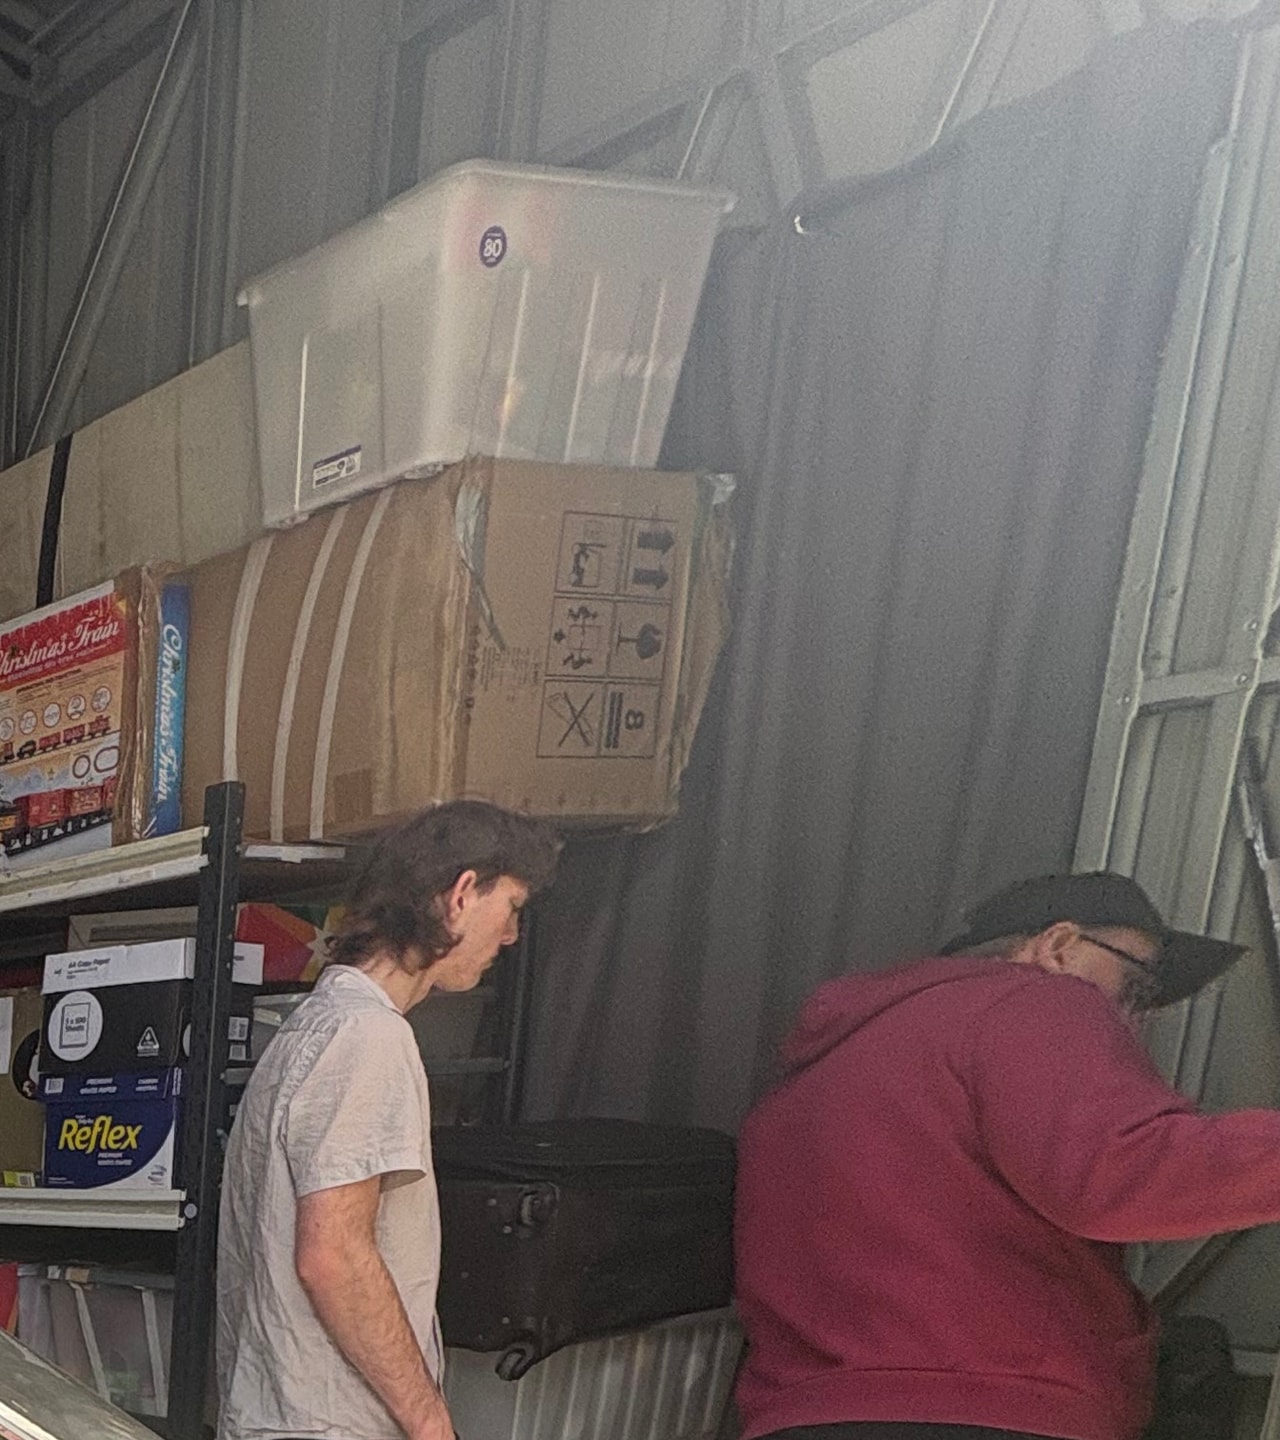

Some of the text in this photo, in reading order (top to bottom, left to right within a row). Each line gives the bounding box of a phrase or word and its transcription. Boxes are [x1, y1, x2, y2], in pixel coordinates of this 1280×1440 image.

[483, 238, 502, 257] 80
[68, 617, 121, 650] Train
[159, 623, 182, 736] Christmas
[156, 739, 179, 803] Train
[58, 1115, 144, 1155] Reflex
